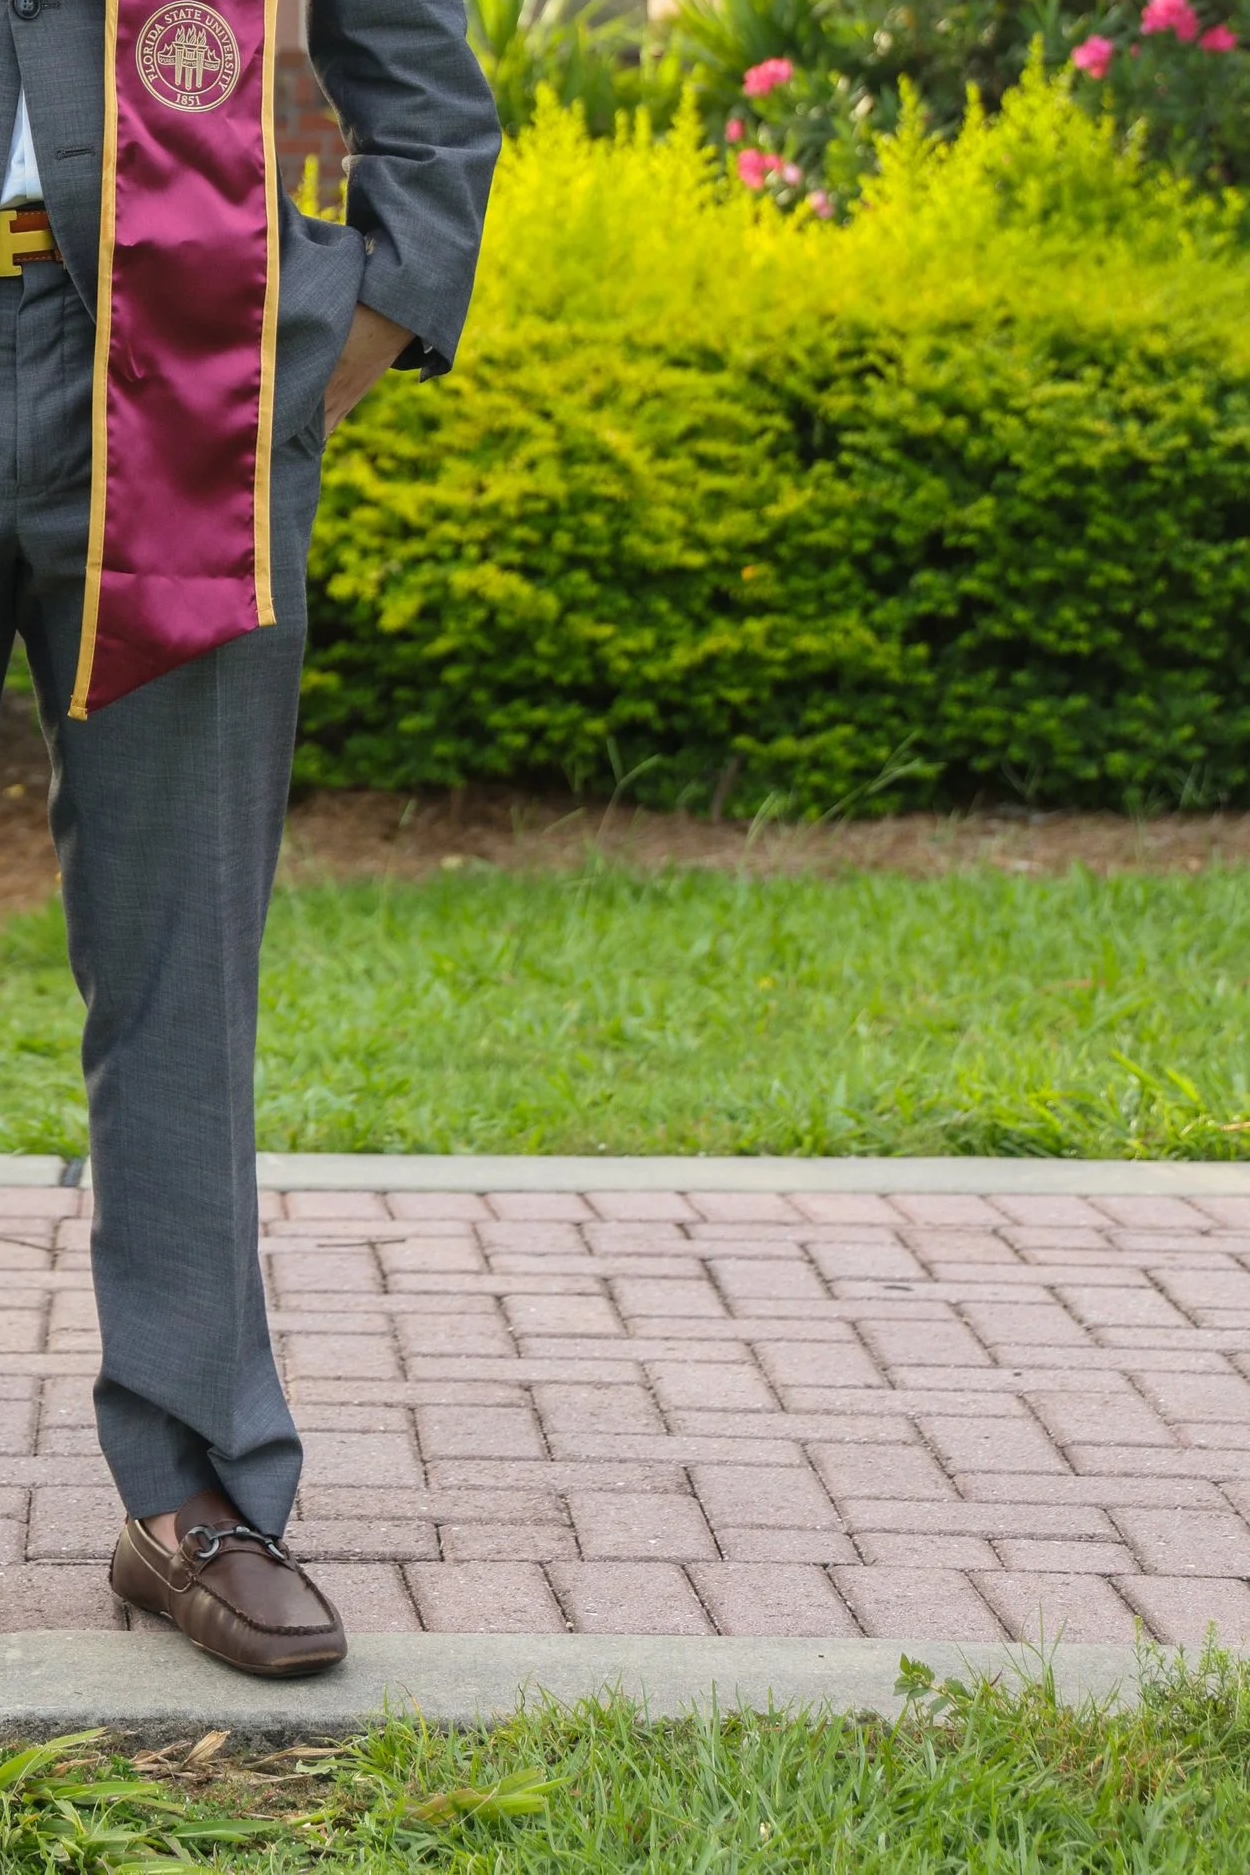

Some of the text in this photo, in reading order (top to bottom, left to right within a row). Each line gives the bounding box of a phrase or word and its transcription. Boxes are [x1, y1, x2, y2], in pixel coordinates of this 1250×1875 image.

[143, 8, 233, 92] FLORIDA STATE UNIVERSITY
[175, 93, 202, 106] 1851
